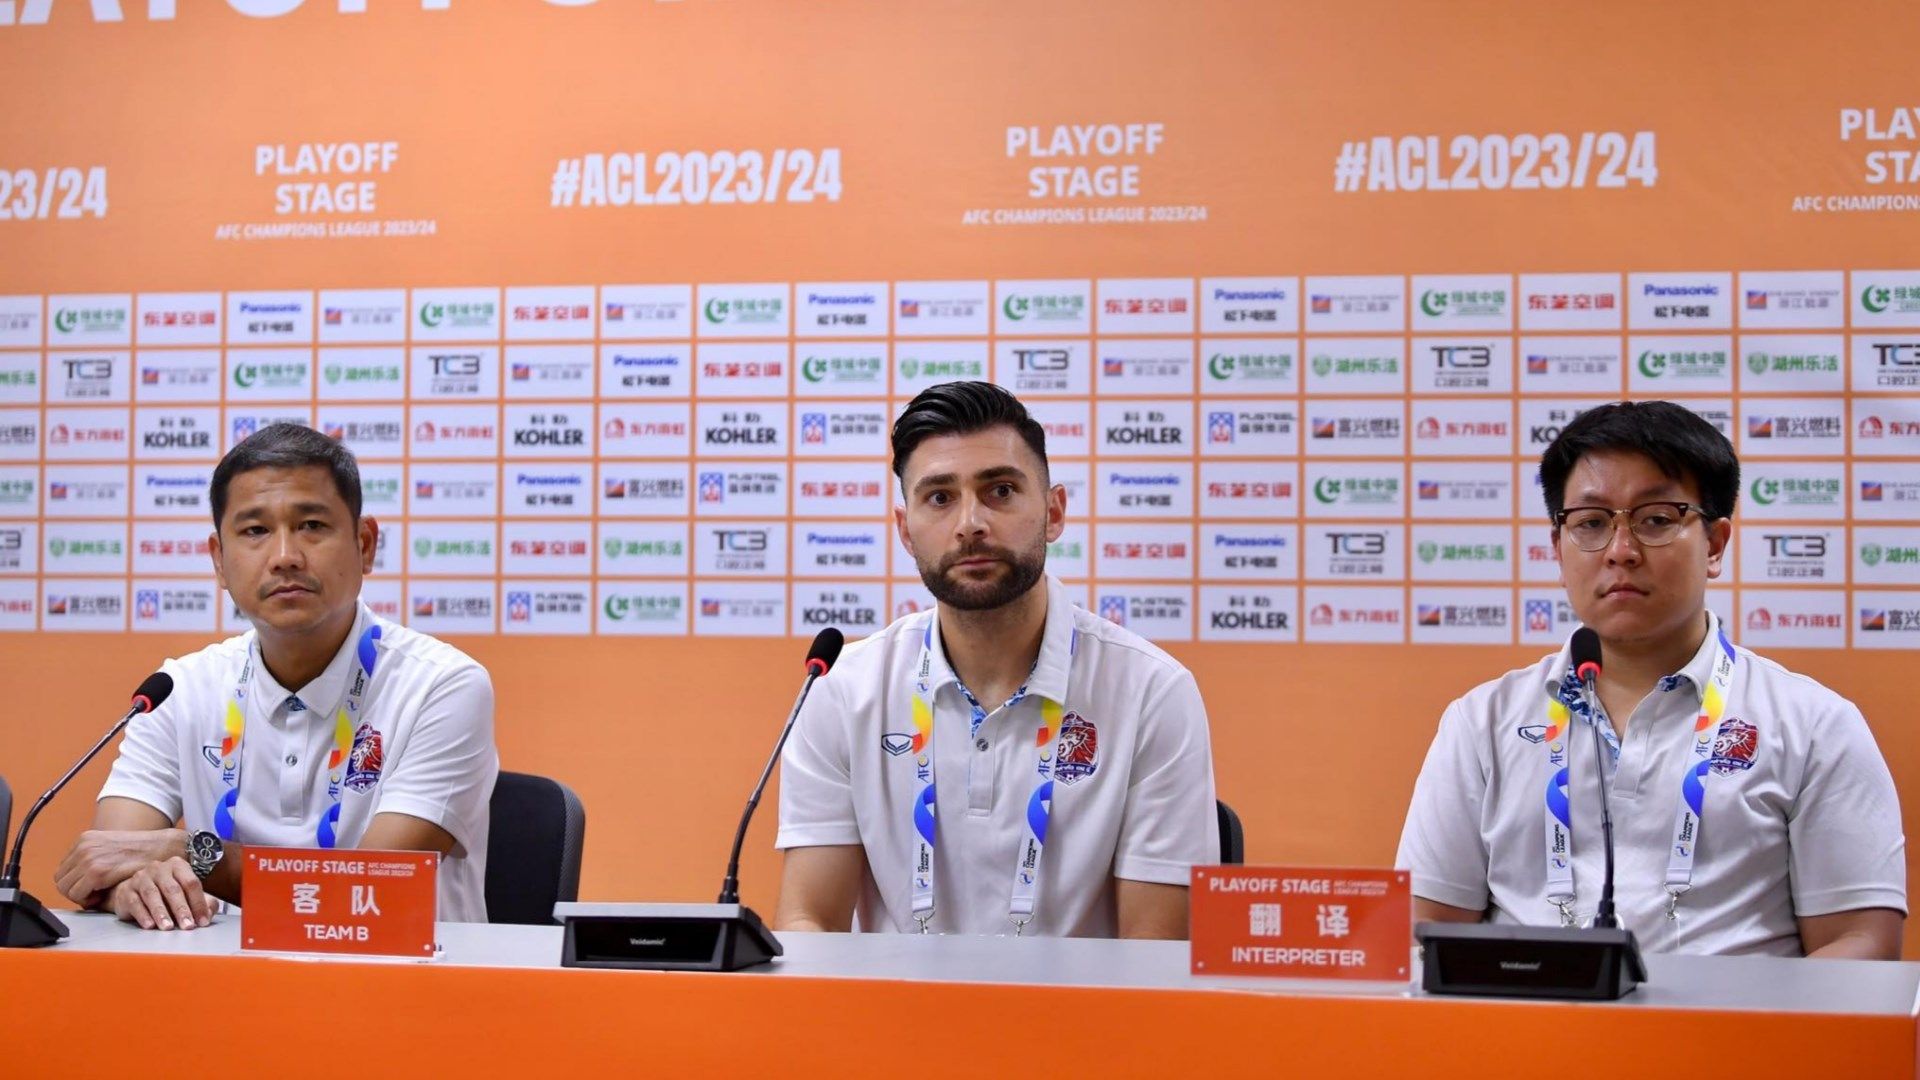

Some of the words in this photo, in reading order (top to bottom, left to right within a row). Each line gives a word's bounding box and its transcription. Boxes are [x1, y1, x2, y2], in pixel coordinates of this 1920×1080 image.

[1840, 107, 1920, 141] PLA
[1006, 123, 1164, 158] PLAYOFF
[255, 142, 399, 175] PLAYOFF
[1334, 131, 1658, 192] #ACL2023/24
[550, 148, 843, 207] #ACL2023/24
[1028, 166, 1140, 198] STAGE
[275, 182, 376, 214] STAGE
[1792, 195, 1823, 212] AFC
[962, 209, 990, 225] AFC
[993, 208, 1085, 224] CHAMPIONS
[1088, 207, 1144, 223] LEAGUE
[1149, 206, 1208, 222] 2023/24
[215, 225, 241, 241] AFC
[243, 223, 326, 239] CHAMPIONS
[329, 221, 380, 238] LEAGUE
[1215, 288, 1284, 300] Panasonic
[1644, 283, 1717, 296] Panasonic
[240, 300, 300, 312] Panasonic
[810, 293, 875, 305] Panasonic
[614, 354, 678, 366] Panasonic
[1873, 342, 1920, 364] TC
[1338, 418, 1398, 432] 富兴燃料
[1774, 416, 1838, 430] 富兴燃料
[144, 430, 209, 445] KOHLER
[514, 429, 582, 444] KOHLER
[707, 428, 777, 444] KOHLER
[1108, 427, 1182, 443] KOHLER
[146, 473, 206, 484] Panasonic
[517, 473, 580, 484] Panasonic
[1111, 473, 1179, 485] Panasonic
[807, 533, 873, 545] Panasonic
[1214, 534, 1283, 546] Panasonic
[803, 608, 874, 624] KOHLER
[1210, 611, 1286, 629] KOHLER
[1445, 605, 1506, 619] 富兴燃料
[1551, 741, 1563, 767] AFC
[1695, 734, 1711, 758] AFC
[223, 760, 236, 787] AFC
[918, 756, 929, 784] AFC
[1038, 751, 1052, 779] AFC
[328, 775, 341, 801] AFC
[258, 857, 319, 873] PLAYOFF
[322, 860, 365, 875] STAGE
[1209, 877, 1278, 893] PLAYOFF
[1282, 879, 1330, 894] STAGE
[304, 924, 352, 941] TEAM
[357, 926, 369, 942] B
[1232, 946, 1365, 967] INTERPRETER
